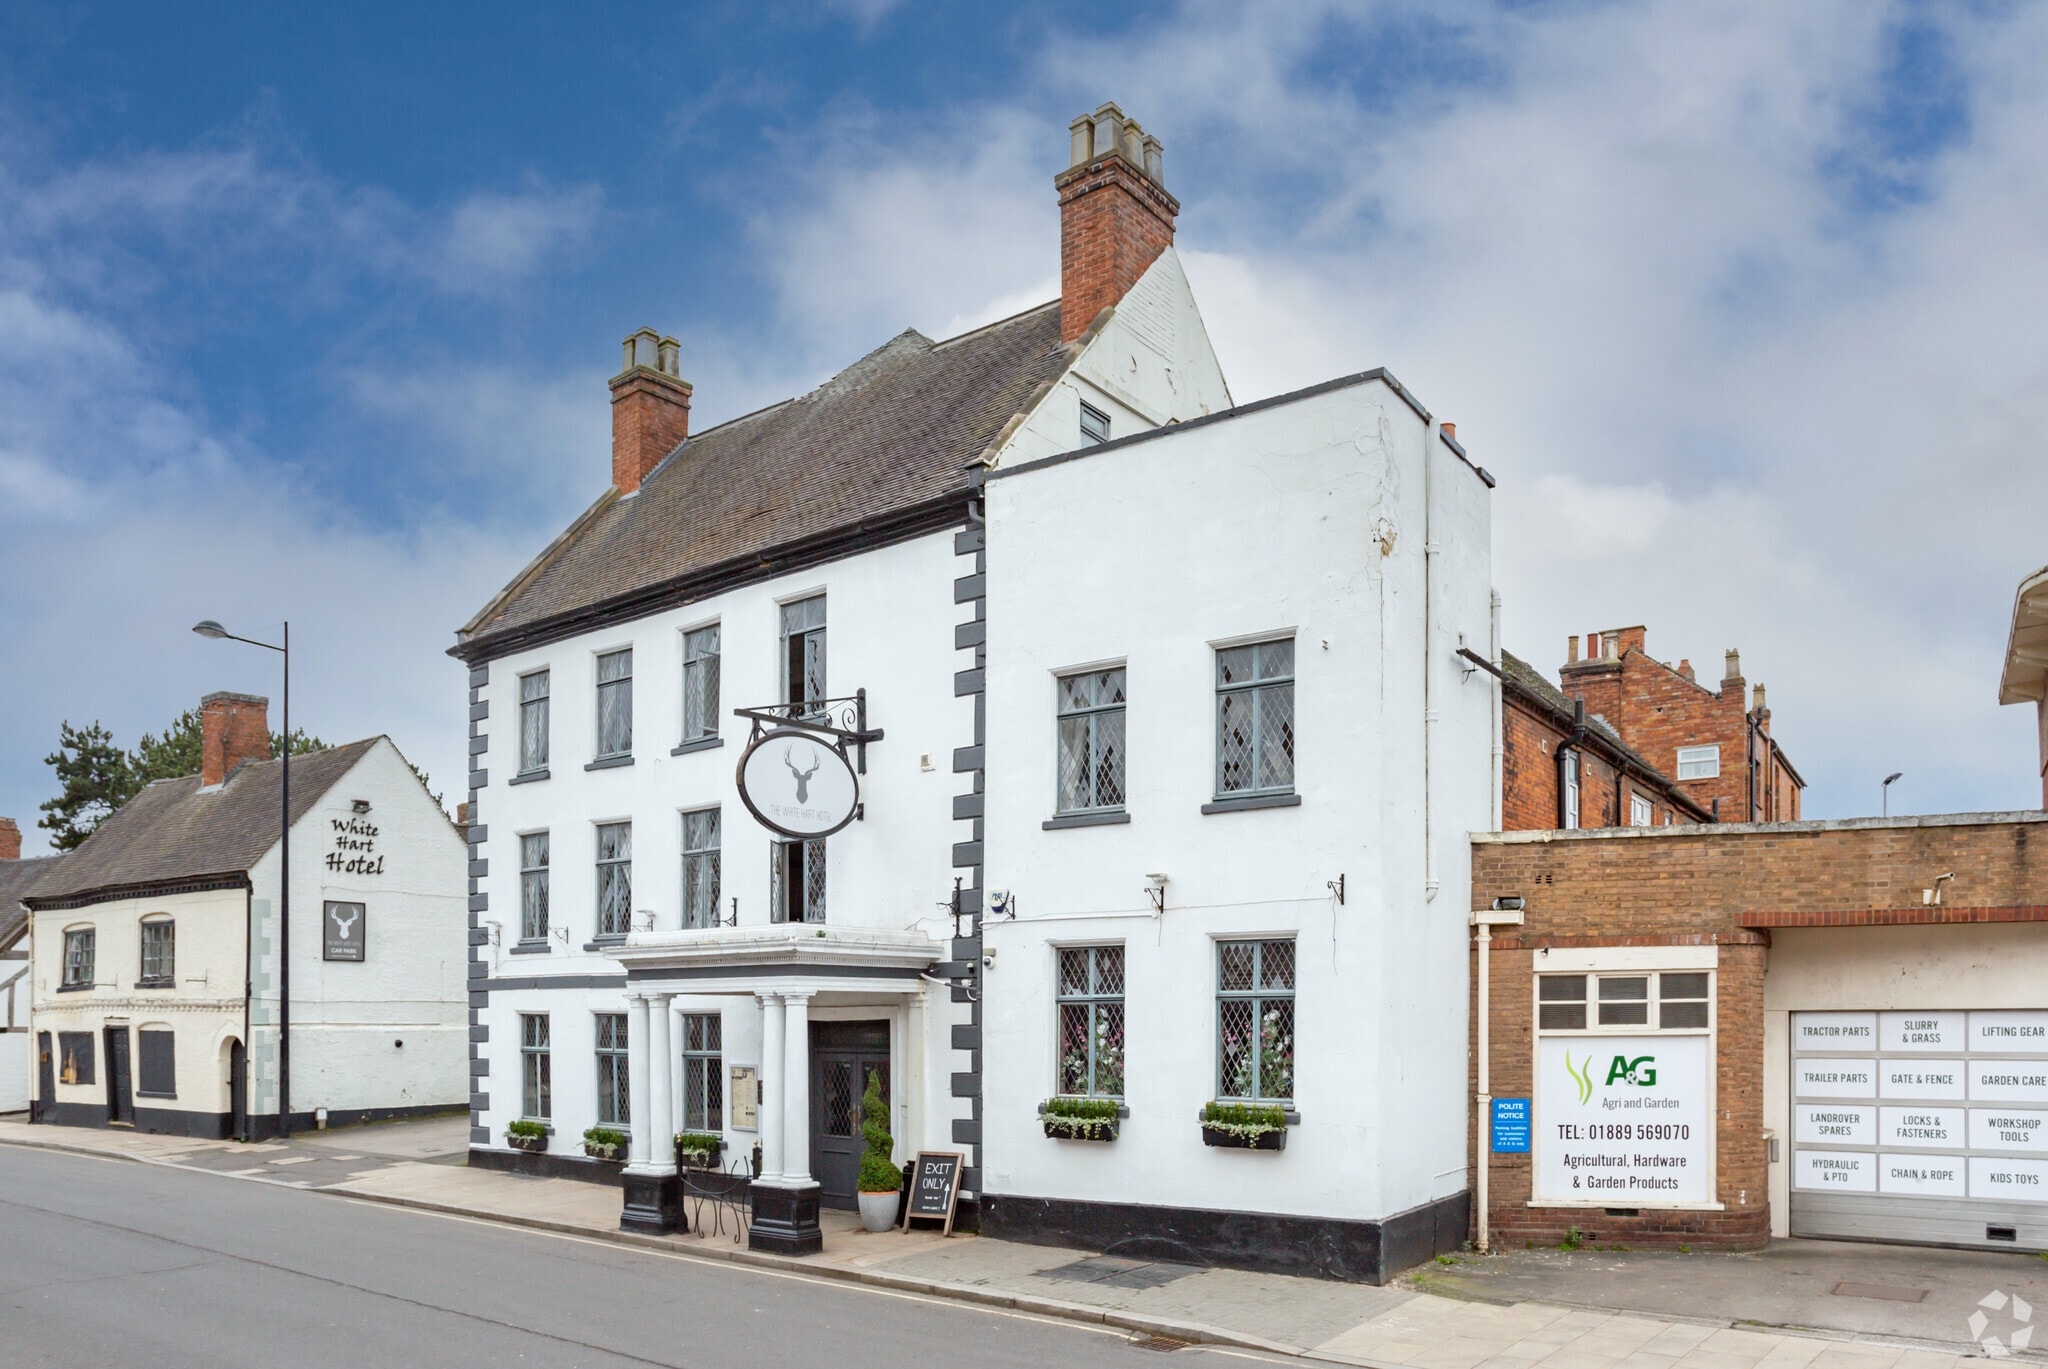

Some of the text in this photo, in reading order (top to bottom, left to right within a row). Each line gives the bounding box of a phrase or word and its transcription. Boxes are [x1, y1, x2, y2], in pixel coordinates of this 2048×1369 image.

[770, 804, 832, 822] THE WHITE HART HOTEL
[331, 818, 379, 836] White
[336, 836, 374, 853] Hart
[326, 852, 384, 875] Hotel
[1904, 1020, 1938, 1030] SLURRY
[1803, 1027, 1870, 1036] TRACTOR PARTS
[1982, 1027, 2045, 1036] LIFTING GEAR
[1902, 1034, 1941, 1042] & GRASS
[1605, 1056, 1656, 1086] A&G
[1804, 1073, 1868, 1083] TRAILER PARTS
[1891, 1074, 1953, 1084] GATE & FENCE
[1982, 1075, 2046, 1086] GARDEN CARE
[1602, 1097, 1679, 1110] Agri and Garden
[1811, 1113, 1860, 1124] LANDROVER
[1903, 1116, 1941, 1126] LOCKS &
[1988, 1118, 2040, 1129] WORKSHOP
[1558, 1125, 1689, 1140] TEL: 01889 569070
[1819, 1126, 1851, 1136] SPARES
[1897, 1128, 1947, 1139] FASTENERS
[2000, 1132, 2029, 1142] TOOLS
[1563, 1154, 1687, 1169] Agricultural, Hardware
[1812, 1160, 1859, 1170] HYDRAULIC
[925, 1163, 953, 1174] EXIT
[1891, 1168, 1954, 1180] CHAIN & ROPE
[1823, 1172, 1848, 1182] & PTO
[1990, 1173, 2039, 1184] KIDS TOYS
[922, 1178, 946, 1190] ONLY
[1572, 1176, 1678, 1190] & Garden Products
